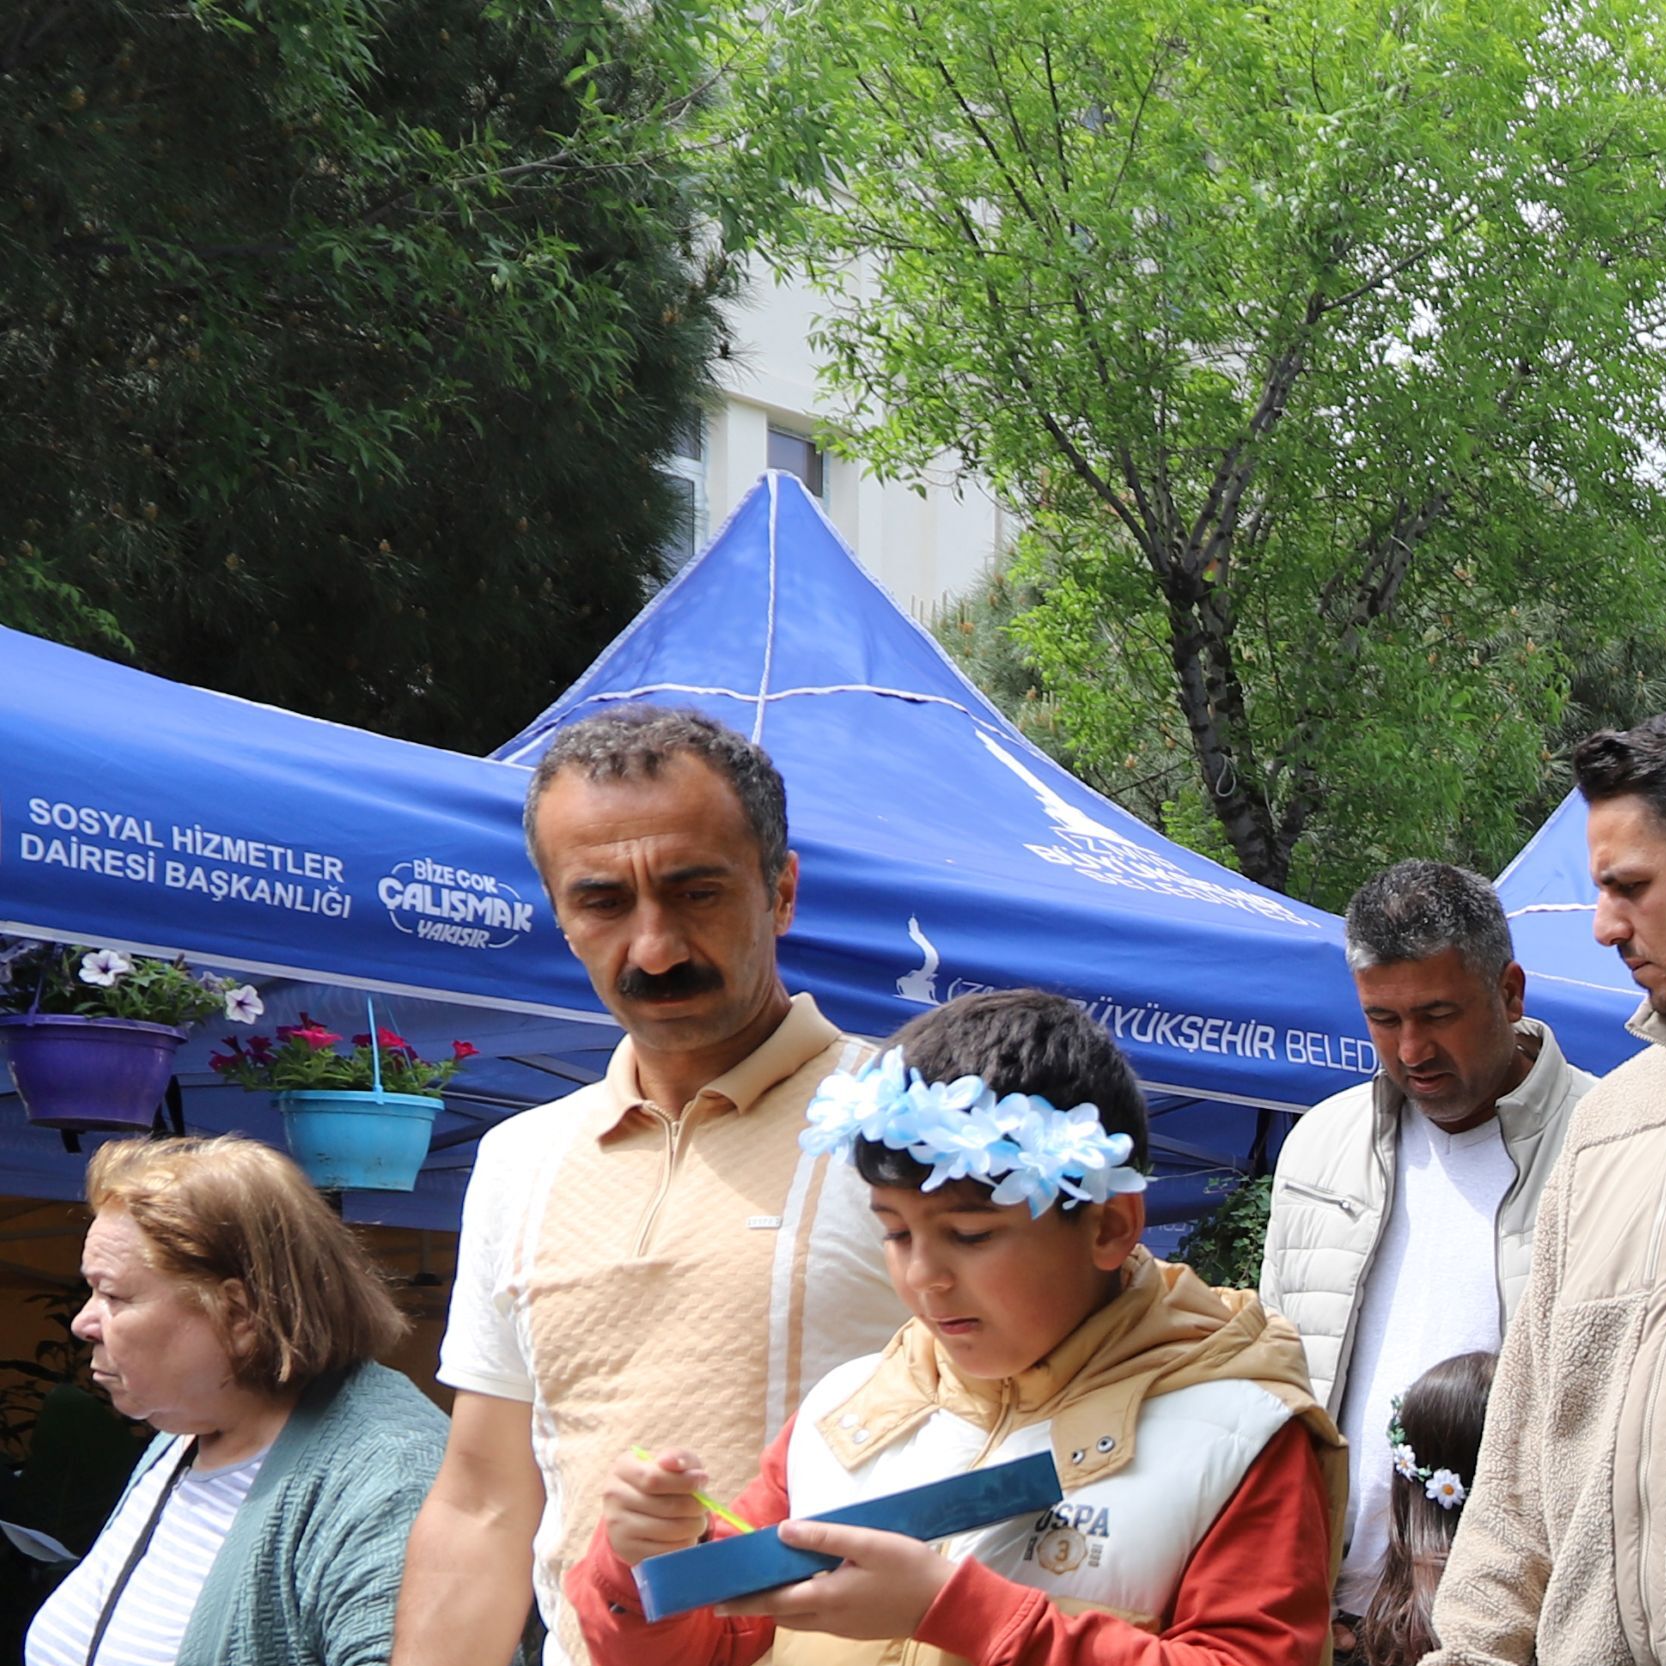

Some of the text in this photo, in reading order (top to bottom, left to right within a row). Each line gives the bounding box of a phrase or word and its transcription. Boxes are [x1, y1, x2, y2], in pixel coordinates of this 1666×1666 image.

[29, 798, 345, 883] SOSYAL HİZMETLER
[21, 832, 352, 919] DAİRESİ BAŞKANLIĞI
[413, 857, 499, 894] BİZE ÇOK
[378, 877, 534, 933] ÇALIŞMAK
[417, 919, 491, 949] YAKIŞIR
[1286, 1029, 1378, 1074] BELED
[1035, 1503, 1110, 1538] USPA
[1055, 1540, 1070, 1562] 3
